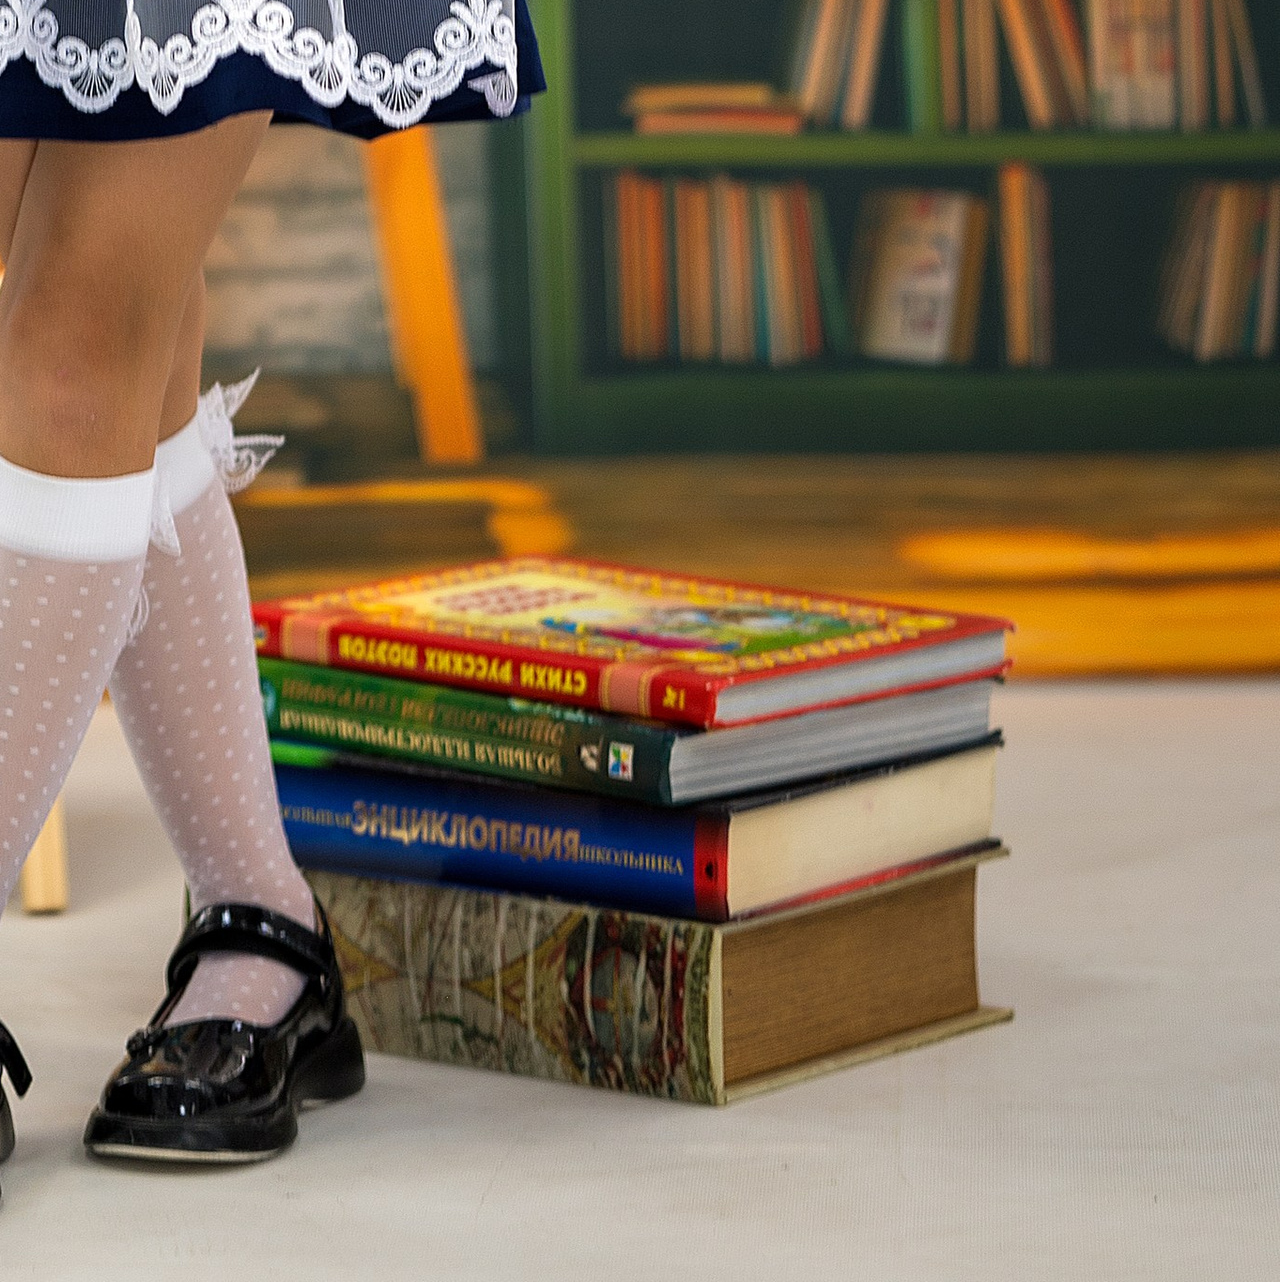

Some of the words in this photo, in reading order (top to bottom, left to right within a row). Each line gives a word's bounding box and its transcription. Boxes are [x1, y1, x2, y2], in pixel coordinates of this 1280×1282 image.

[337, 633, 418, 670] ПОЭТОВ
[423, 645, 514, 685] РУССКИХ
[519, 661, 588, 698] СТИХИ
[474, 739, 564, 778] БОЛЬШАЯ
[351, 800, 582, 862] ЭНЦИКЛОПЕДИЯ
[579, 844, 685, 877] ШКОЛЬНИКА
